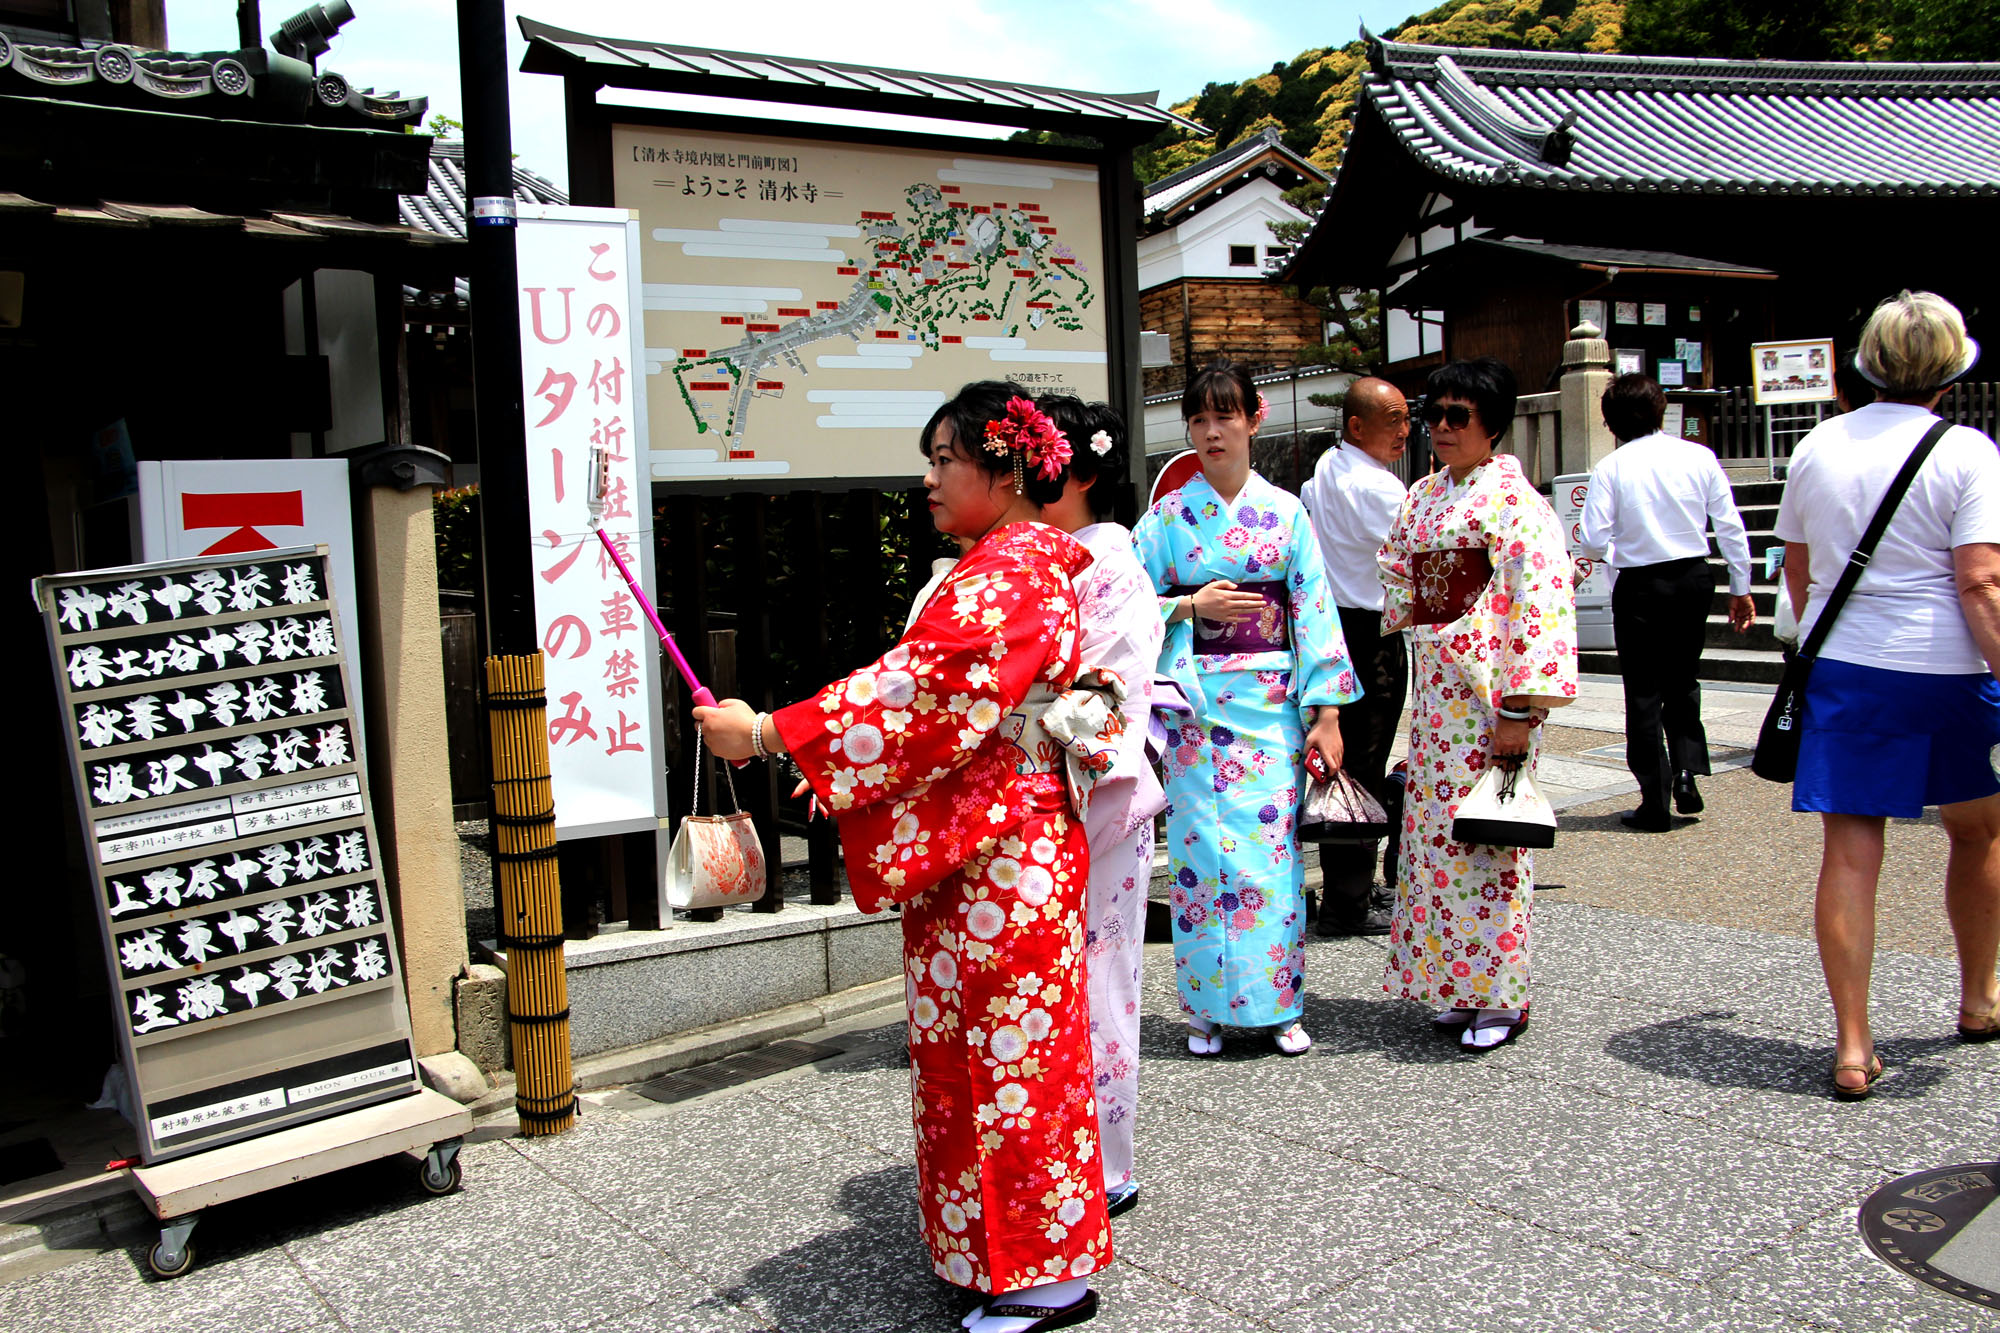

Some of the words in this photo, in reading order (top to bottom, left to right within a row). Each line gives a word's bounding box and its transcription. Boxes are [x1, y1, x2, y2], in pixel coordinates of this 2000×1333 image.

[633, 146, 798, 172] 【清水寺境内図と門前町図】
[682, 175, 748, 199] ようこそ
[759, 178, 818, 203] 清水寺
[1684, 417, 1700, 437] 真
[586, 242, 645, 757] この付近駐停車禁止
[522, 287, 598, 747] Uターンのみ
[352, 1070, 387, 1084] TOUR
